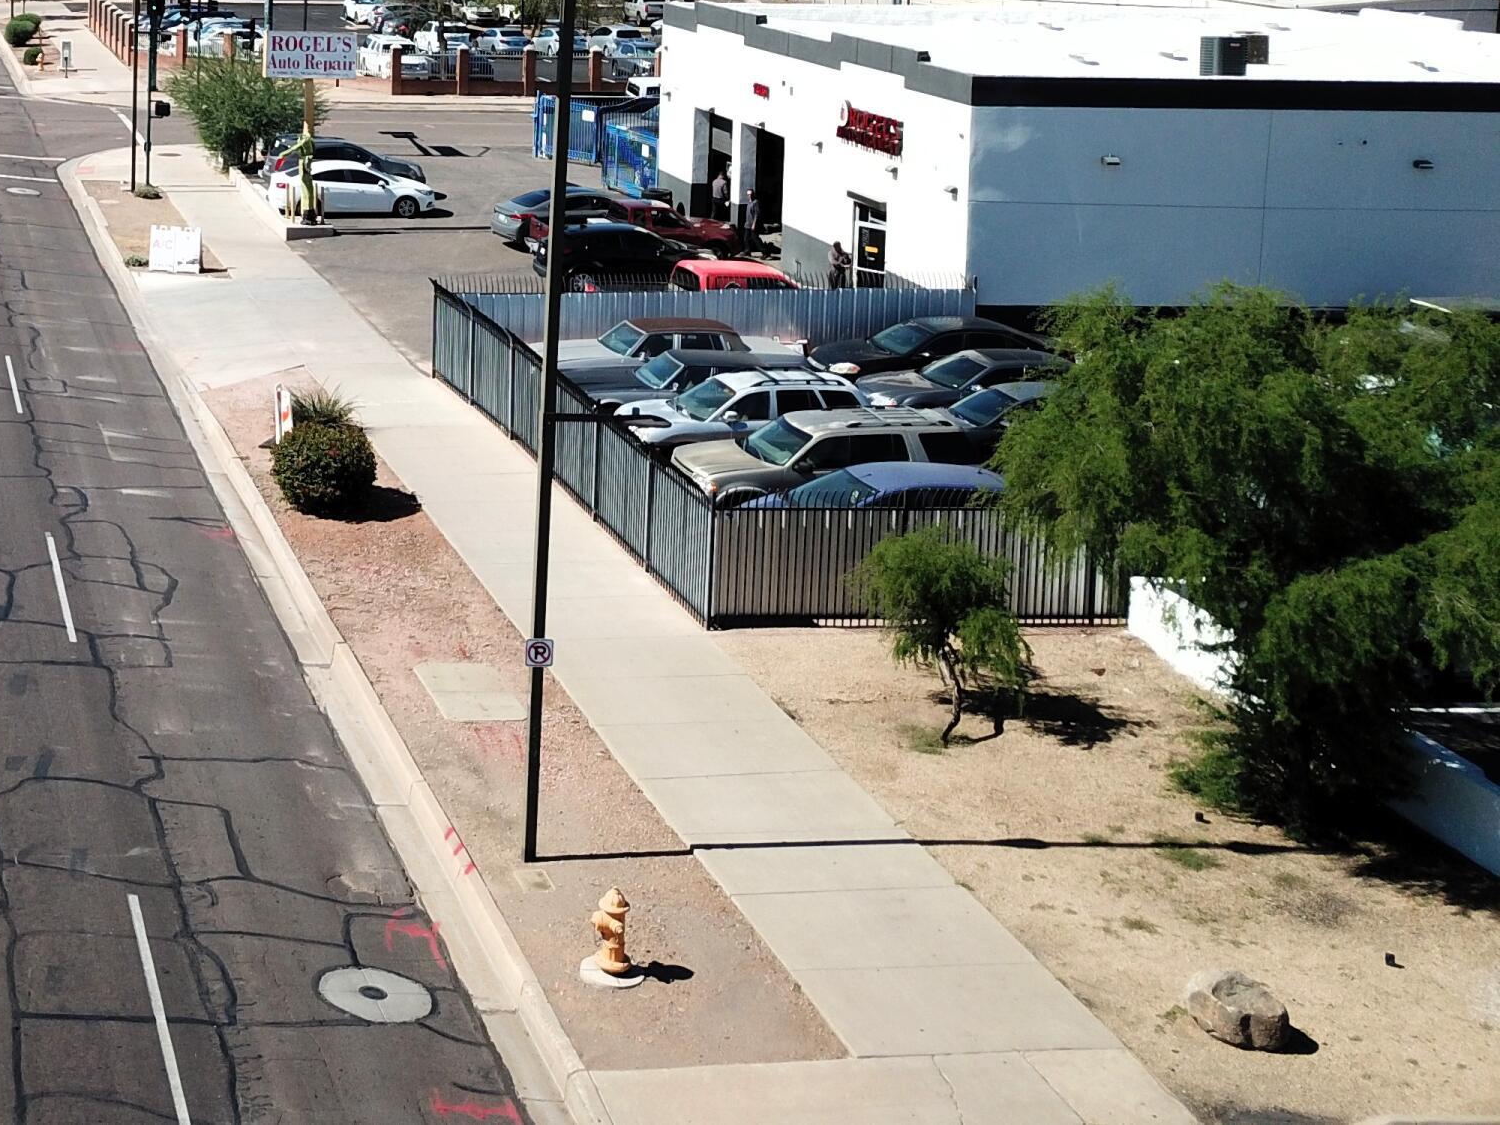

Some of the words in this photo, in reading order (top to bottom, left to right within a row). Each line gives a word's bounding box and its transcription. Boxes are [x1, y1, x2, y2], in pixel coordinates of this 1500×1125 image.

[271, 35, 352, 53] ROGEL'S
[268, 53, 300, 70] Auto
[305, 53, 356, 73] Repair
